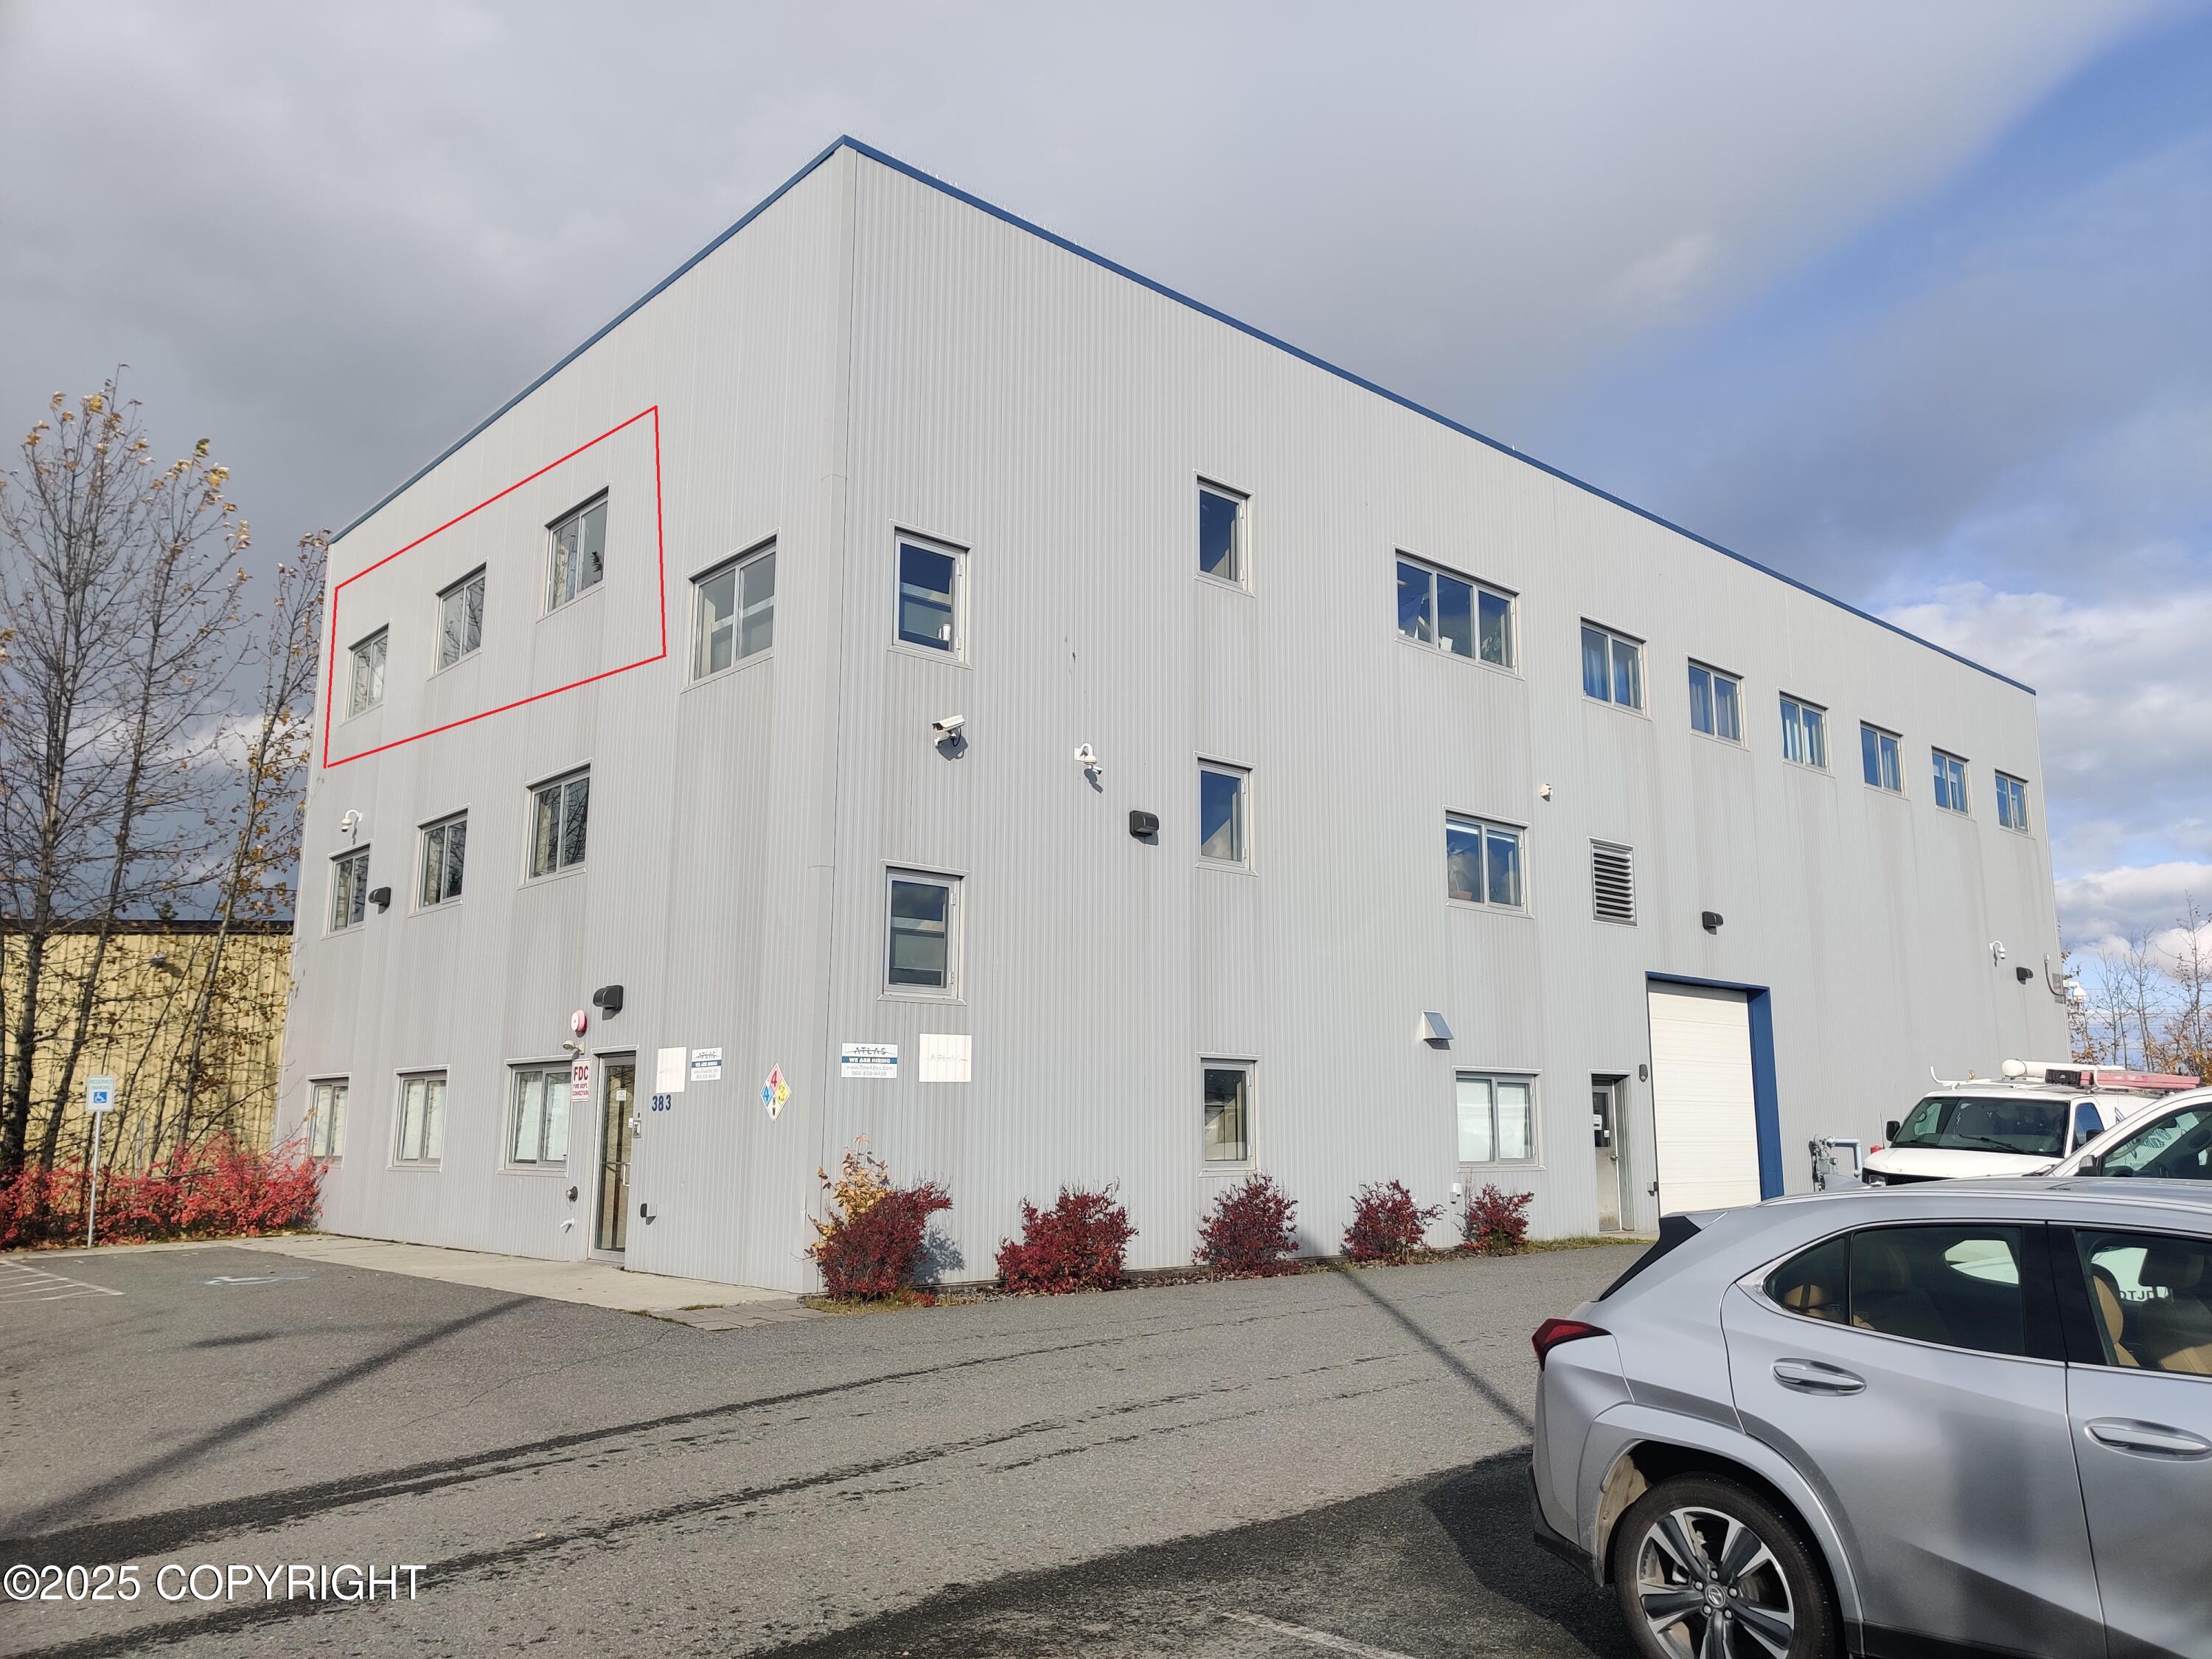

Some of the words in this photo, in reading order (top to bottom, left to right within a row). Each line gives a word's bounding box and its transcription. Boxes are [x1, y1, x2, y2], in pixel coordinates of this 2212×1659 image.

[855, 1046, 886, 1055] ATLAS
[574, 1065, 588, 1081] FDC
[771, 1070, 777, 1088] 4
[763, 1086, 770, 1102] 4
[652, 1094, 672, 1112] 383
